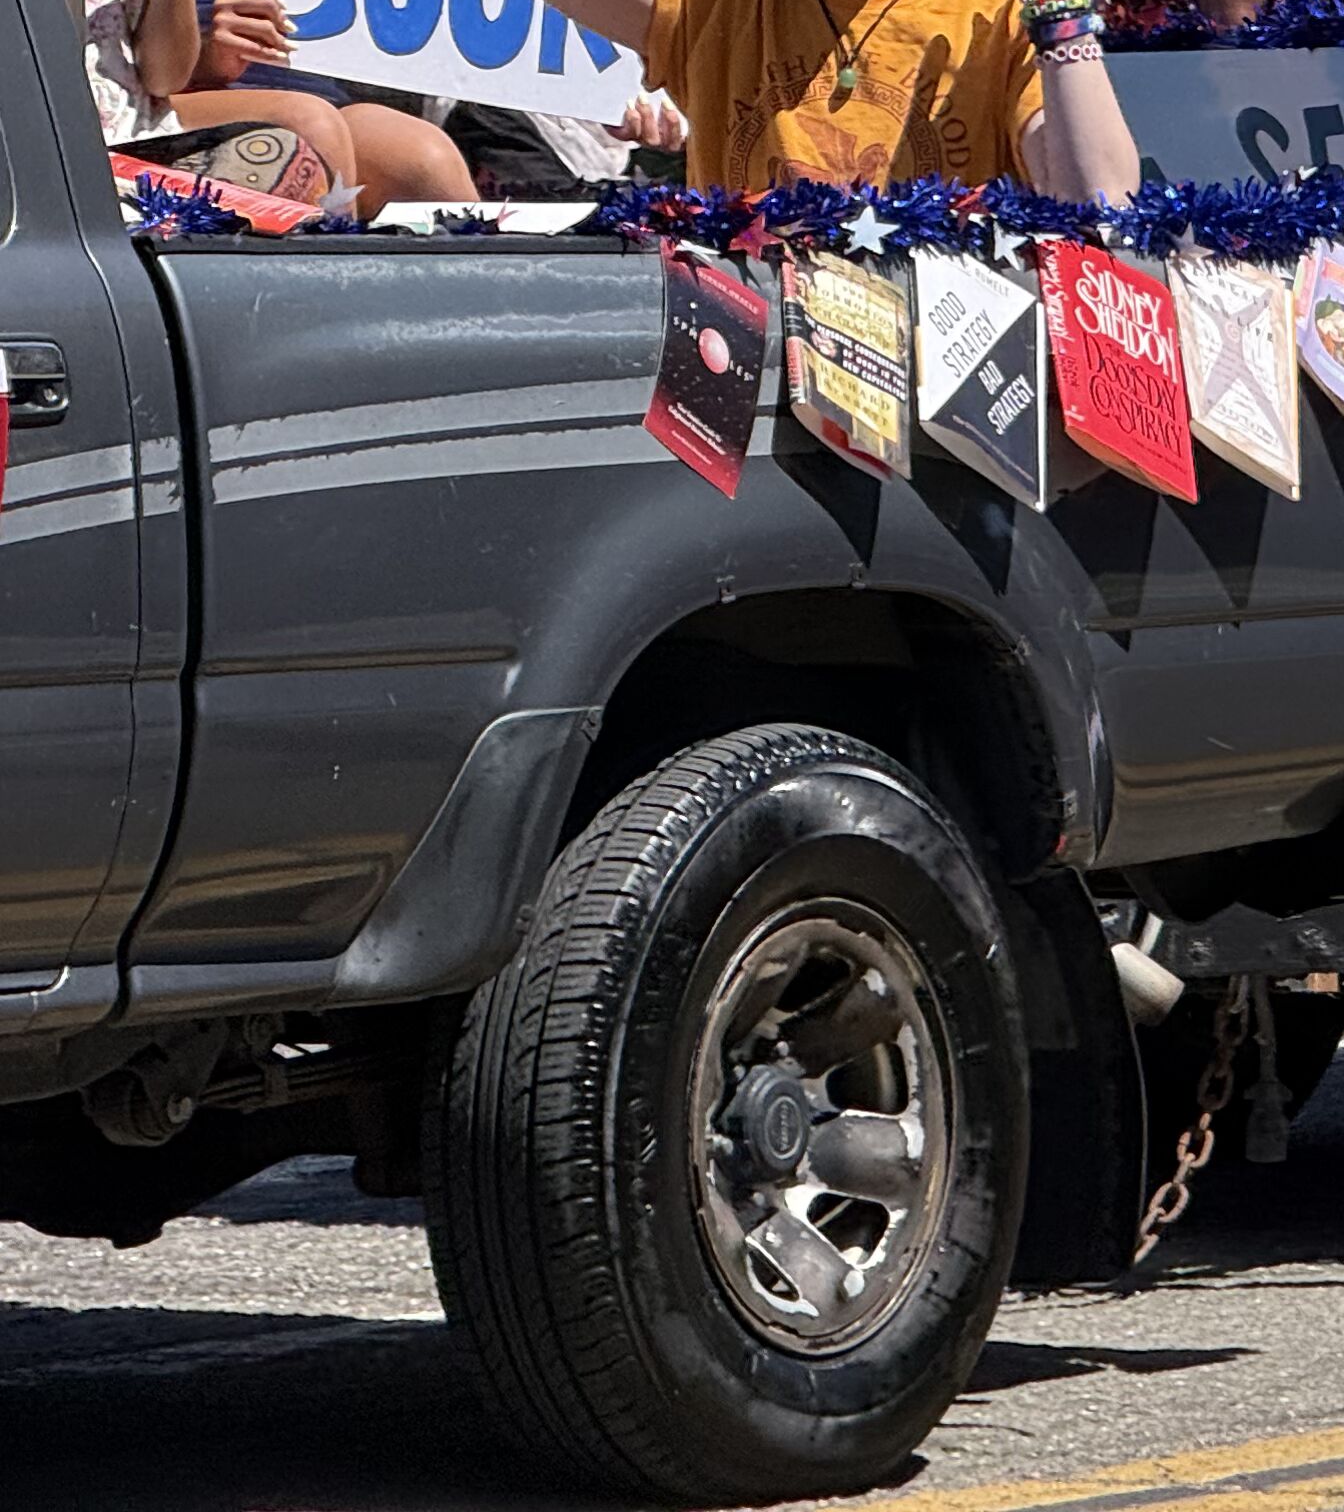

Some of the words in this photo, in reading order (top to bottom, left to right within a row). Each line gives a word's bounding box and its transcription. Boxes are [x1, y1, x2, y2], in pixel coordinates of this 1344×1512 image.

[927, 291, 967, 337] GOOD
[1075, 260, 1163, 334] SIDNEY
[942, 309, 998, 379] STRATEGY
[977, 359, 1005, 396] BAD
[1074, 300, 1179, 385] SHELDON
[987, 373, 1036, 436] STRATEGY
[1089, 375, 1182, 459] CONSPIRACY
